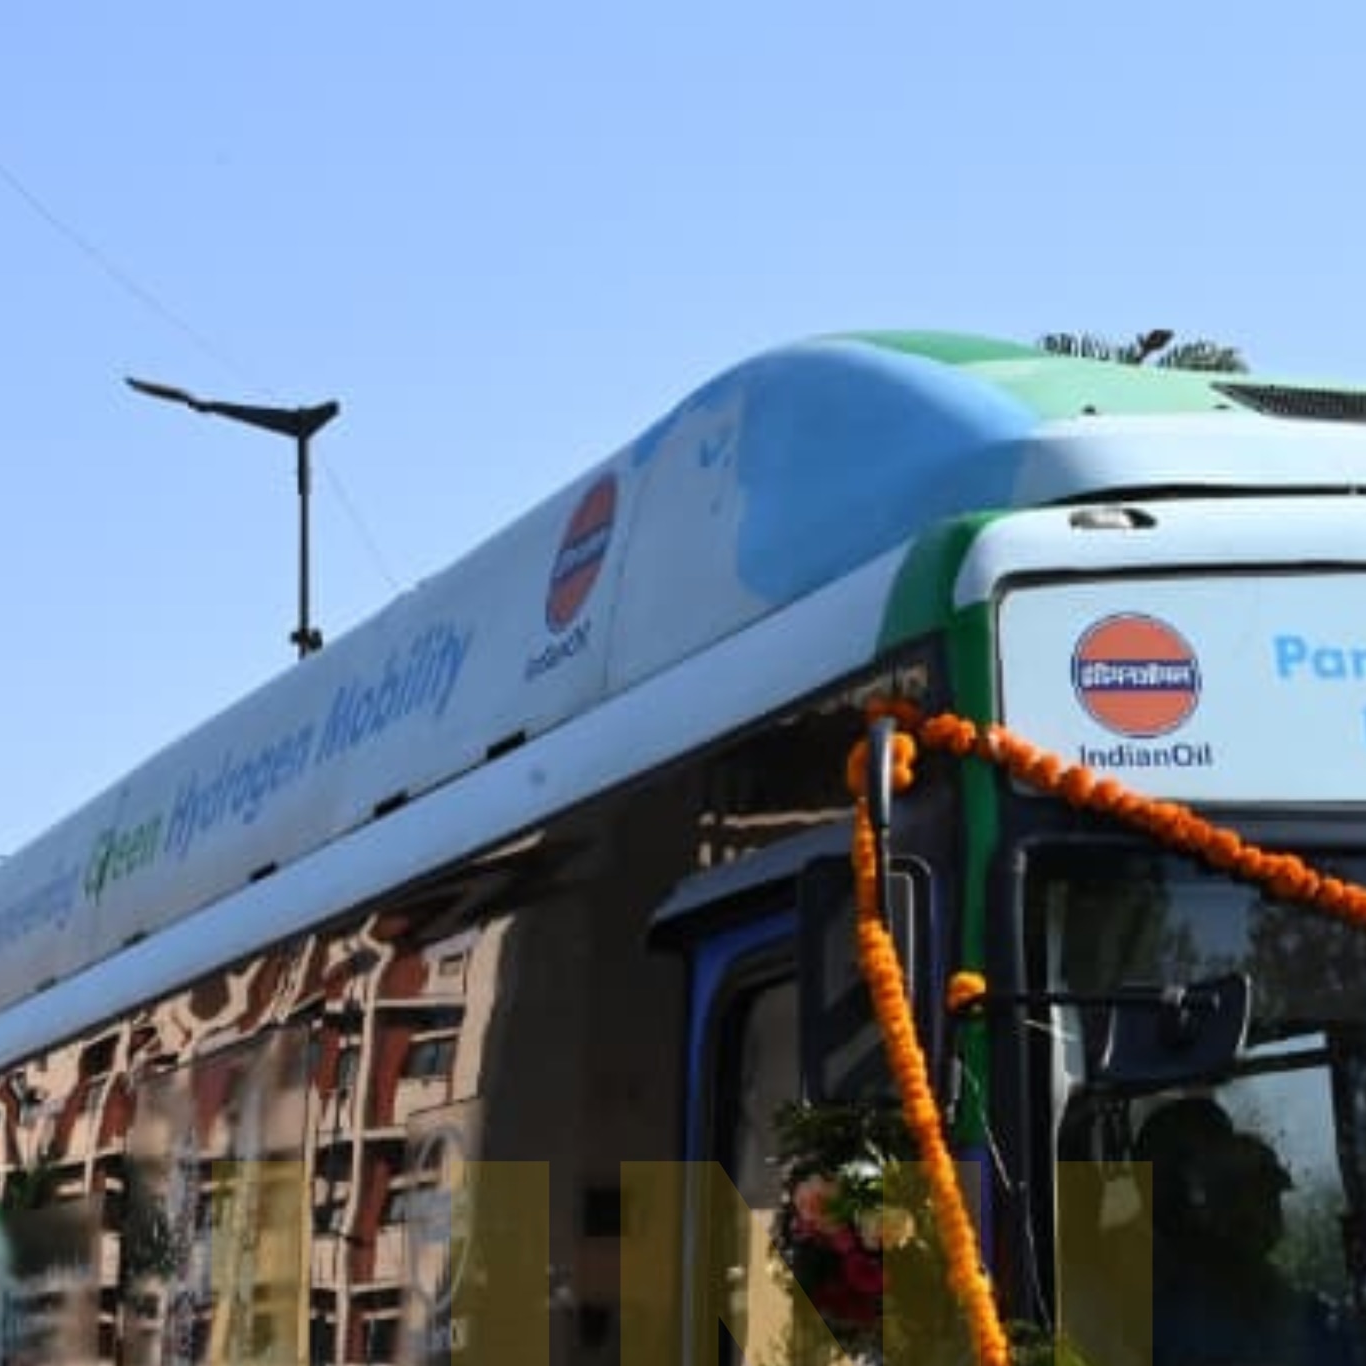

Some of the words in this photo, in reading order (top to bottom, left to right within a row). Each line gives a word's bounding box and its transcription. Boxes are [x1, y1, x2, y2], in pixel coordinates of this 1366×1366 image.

[165, 725, 314, 859] Hydrogen
[319, 626, 472, 763] Mobility
[1080, 742, 1213, 768] IndianOil
